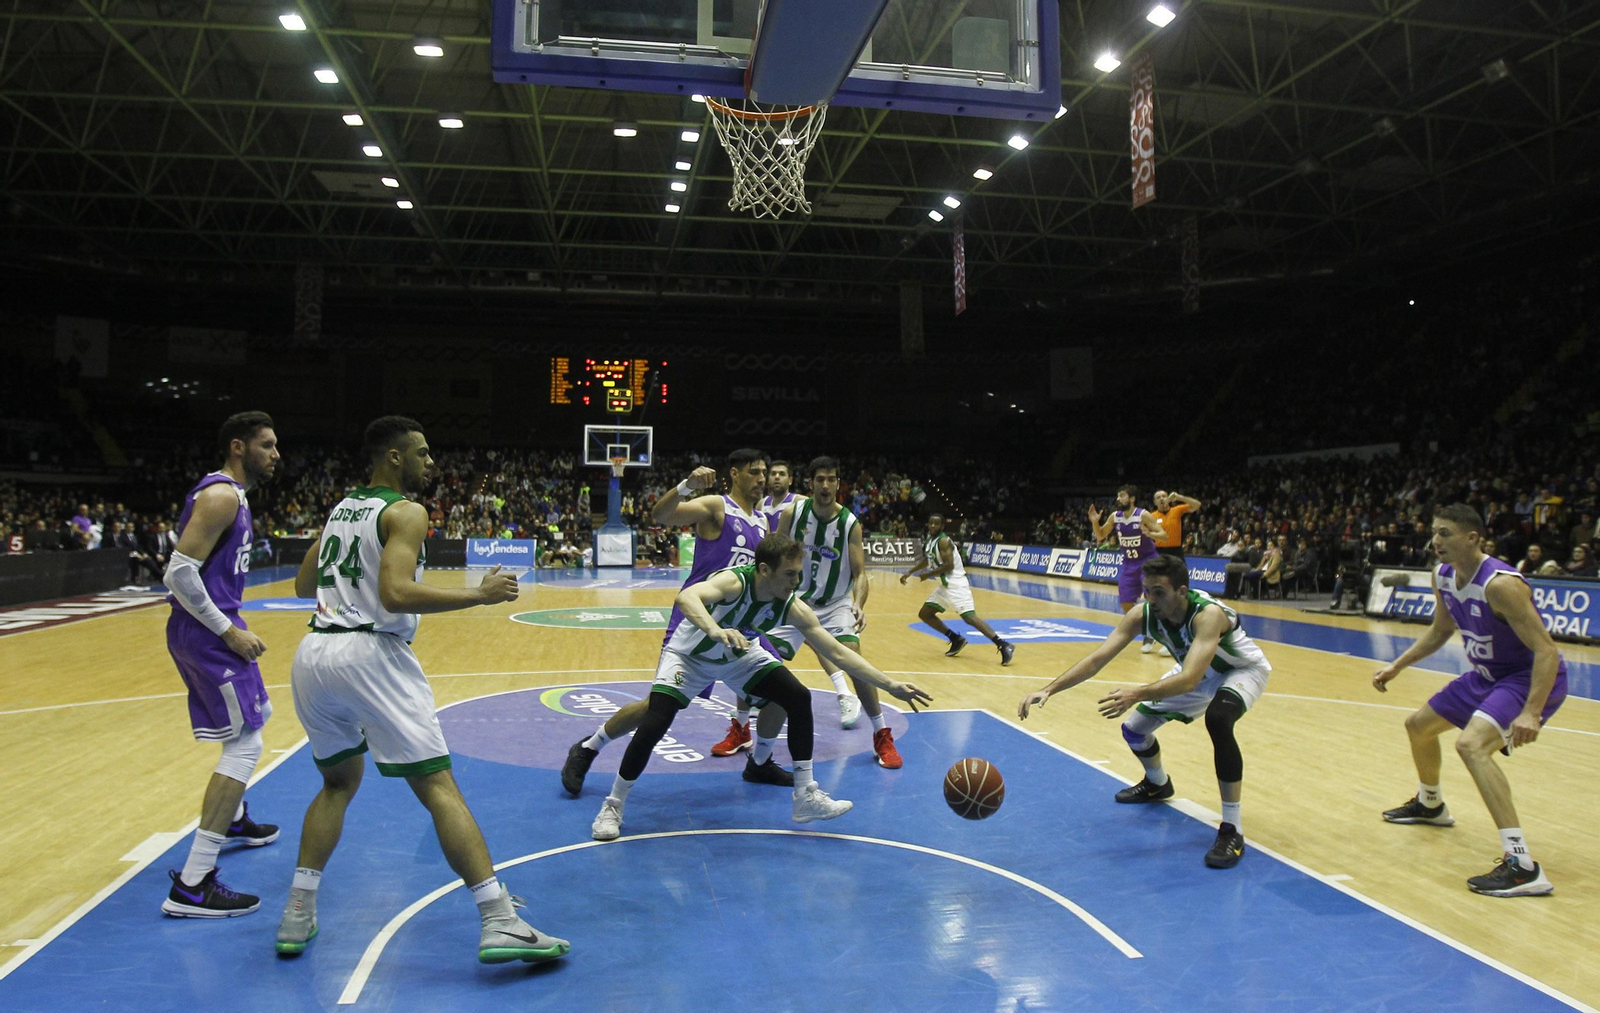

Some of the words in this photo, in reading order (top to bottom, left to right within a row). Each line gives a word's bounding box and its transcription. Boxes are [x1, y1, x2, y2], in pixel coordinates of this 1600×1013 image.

[731, 386, 820, 402] SEVILLA
[330, 507, 374, 524] LOCKETT
[10, 535, 25, 552] 5
[861, 541, 915, 556] HGATE
[1118, 534, 1142, 548] Teka
[871, 556, 894, 564] Renting
[1115, 554, 1125, 566] DE
[1125, 549, 1139, 559] 23
[317, 534, 364, 590] 24
[1096, 565, 1119, 578] EQUIPO
[1533, 587, 1591, 614] BAJO
